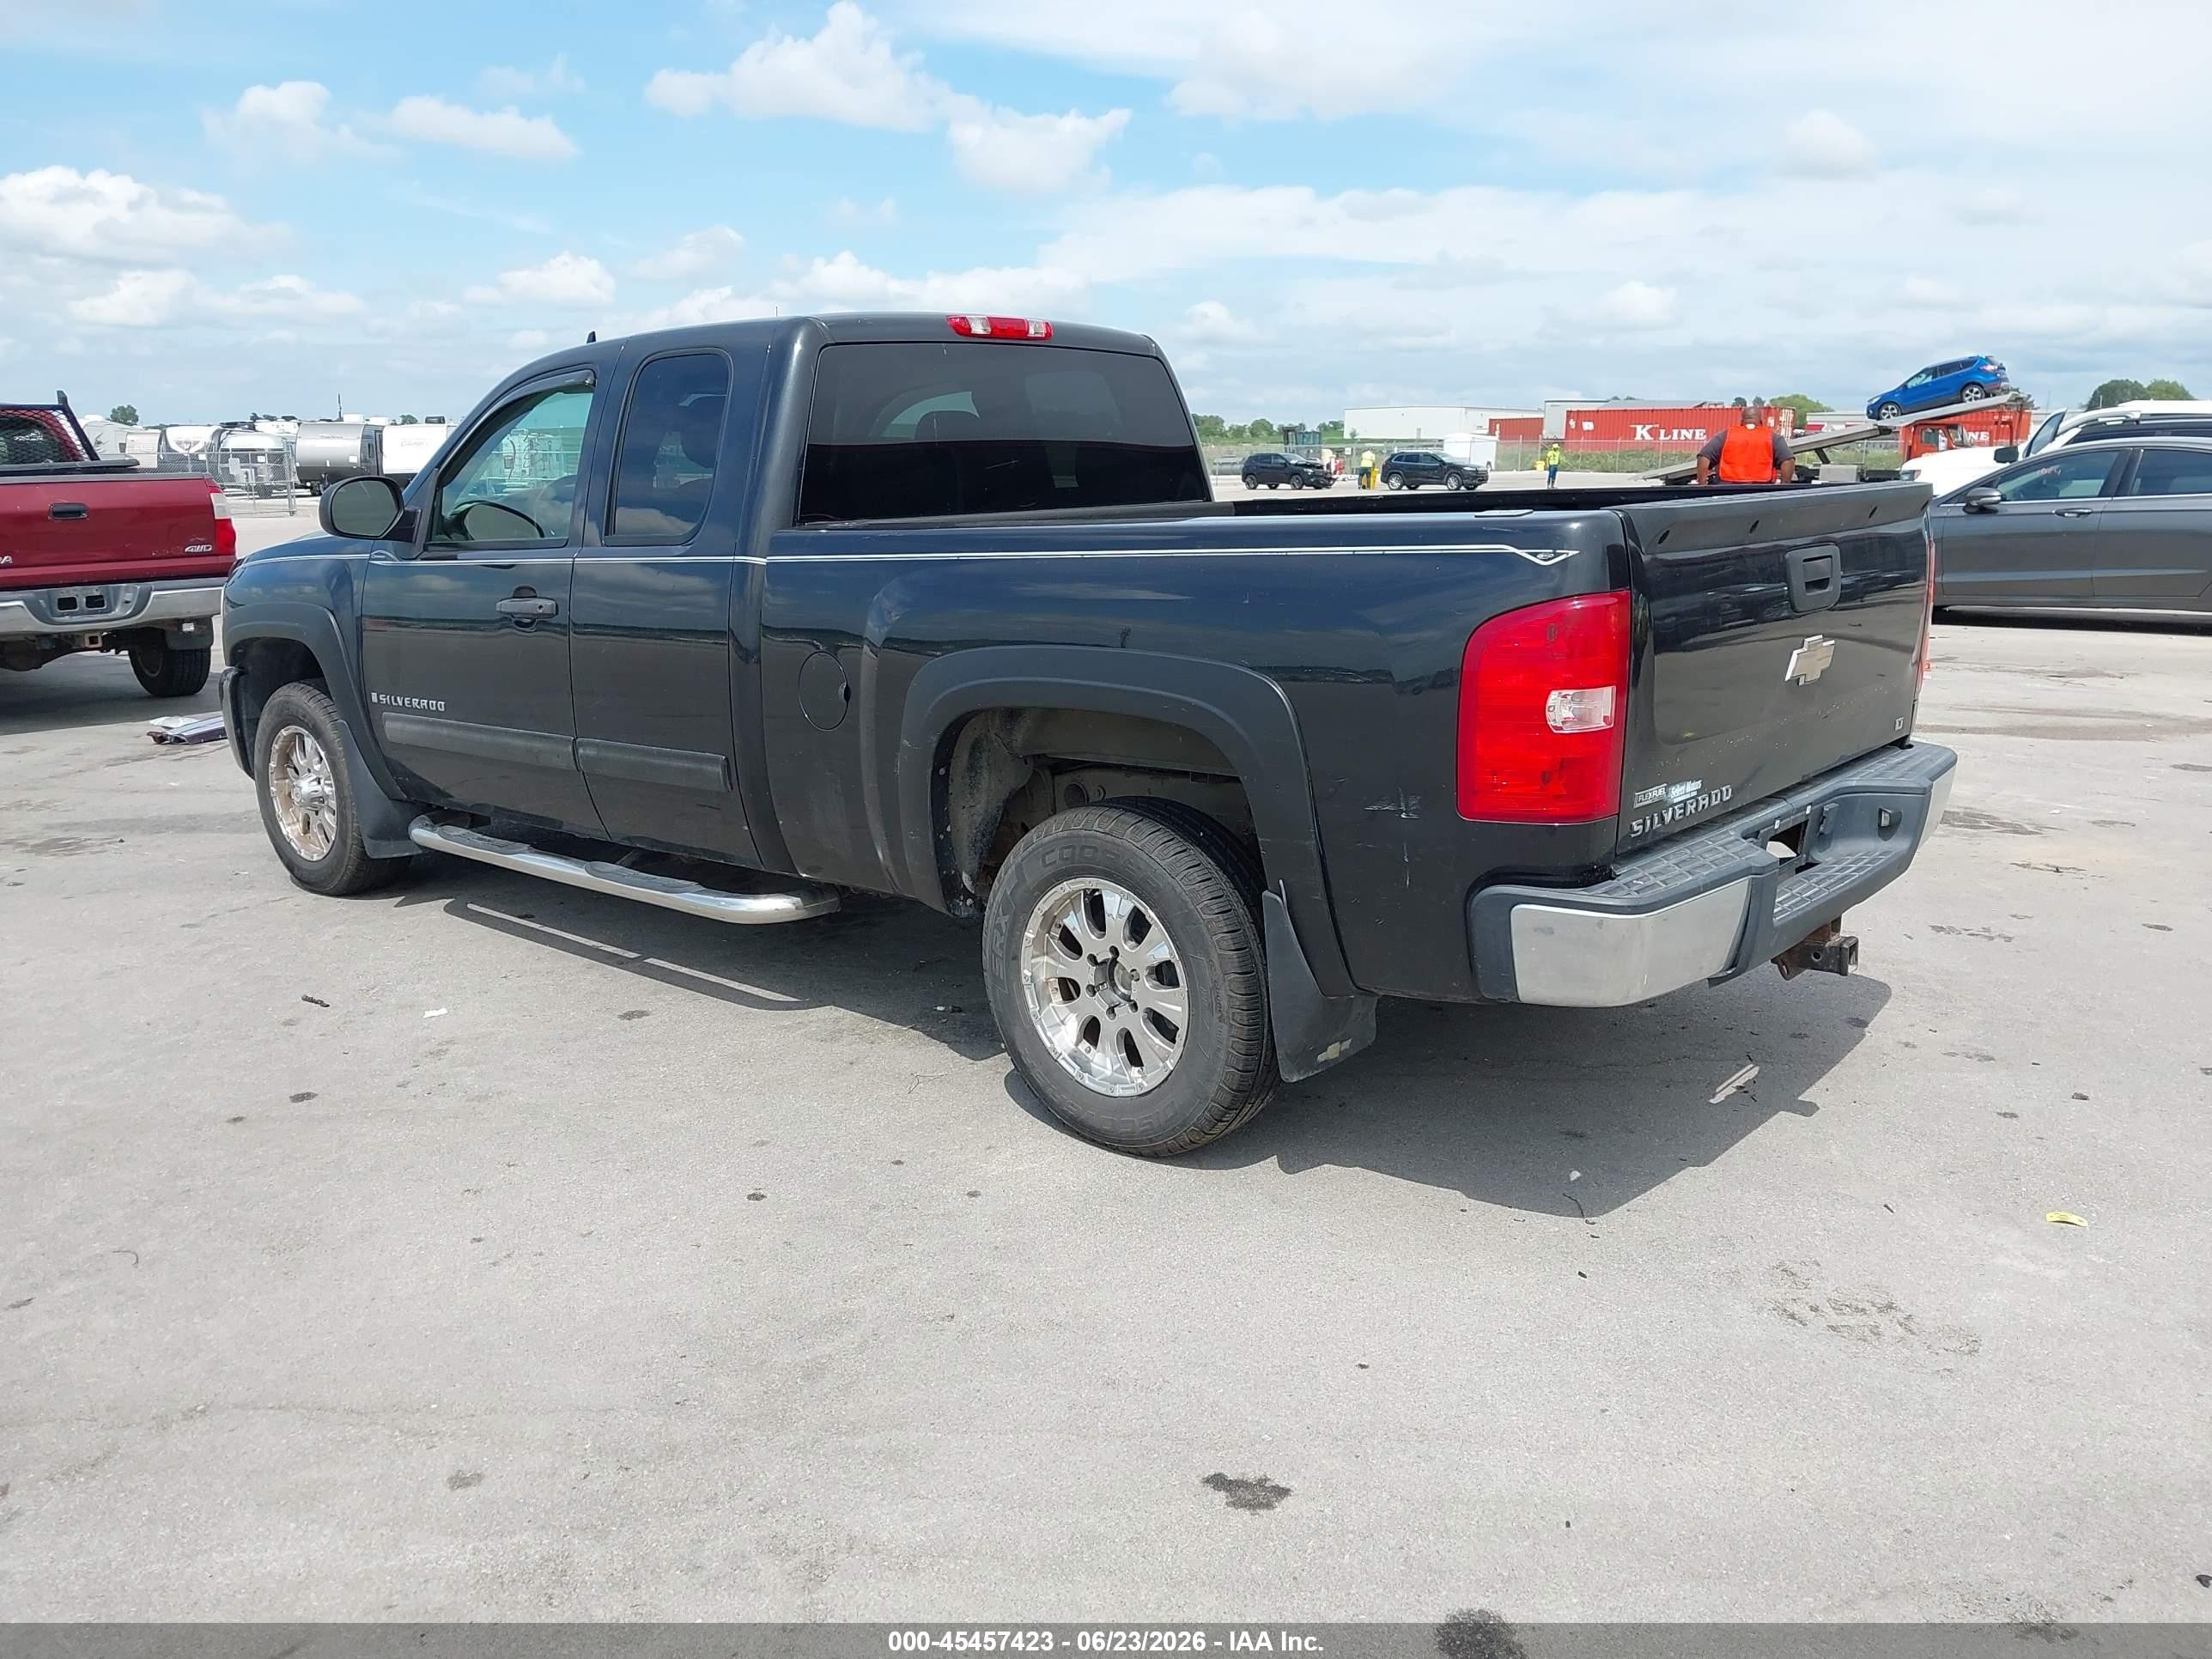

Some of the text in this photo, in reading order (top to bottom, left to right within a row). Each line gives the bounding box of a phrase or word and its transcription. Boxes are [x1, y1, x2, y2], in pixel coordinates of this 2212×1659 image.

[1630, 424, 1707, 441] K LINE
[379, 693, 446, 712] SILVERADO
[1638, 787, 1666, 802] FLEXFUEL
[1630, 784, 1733, 838] SILVERADO
